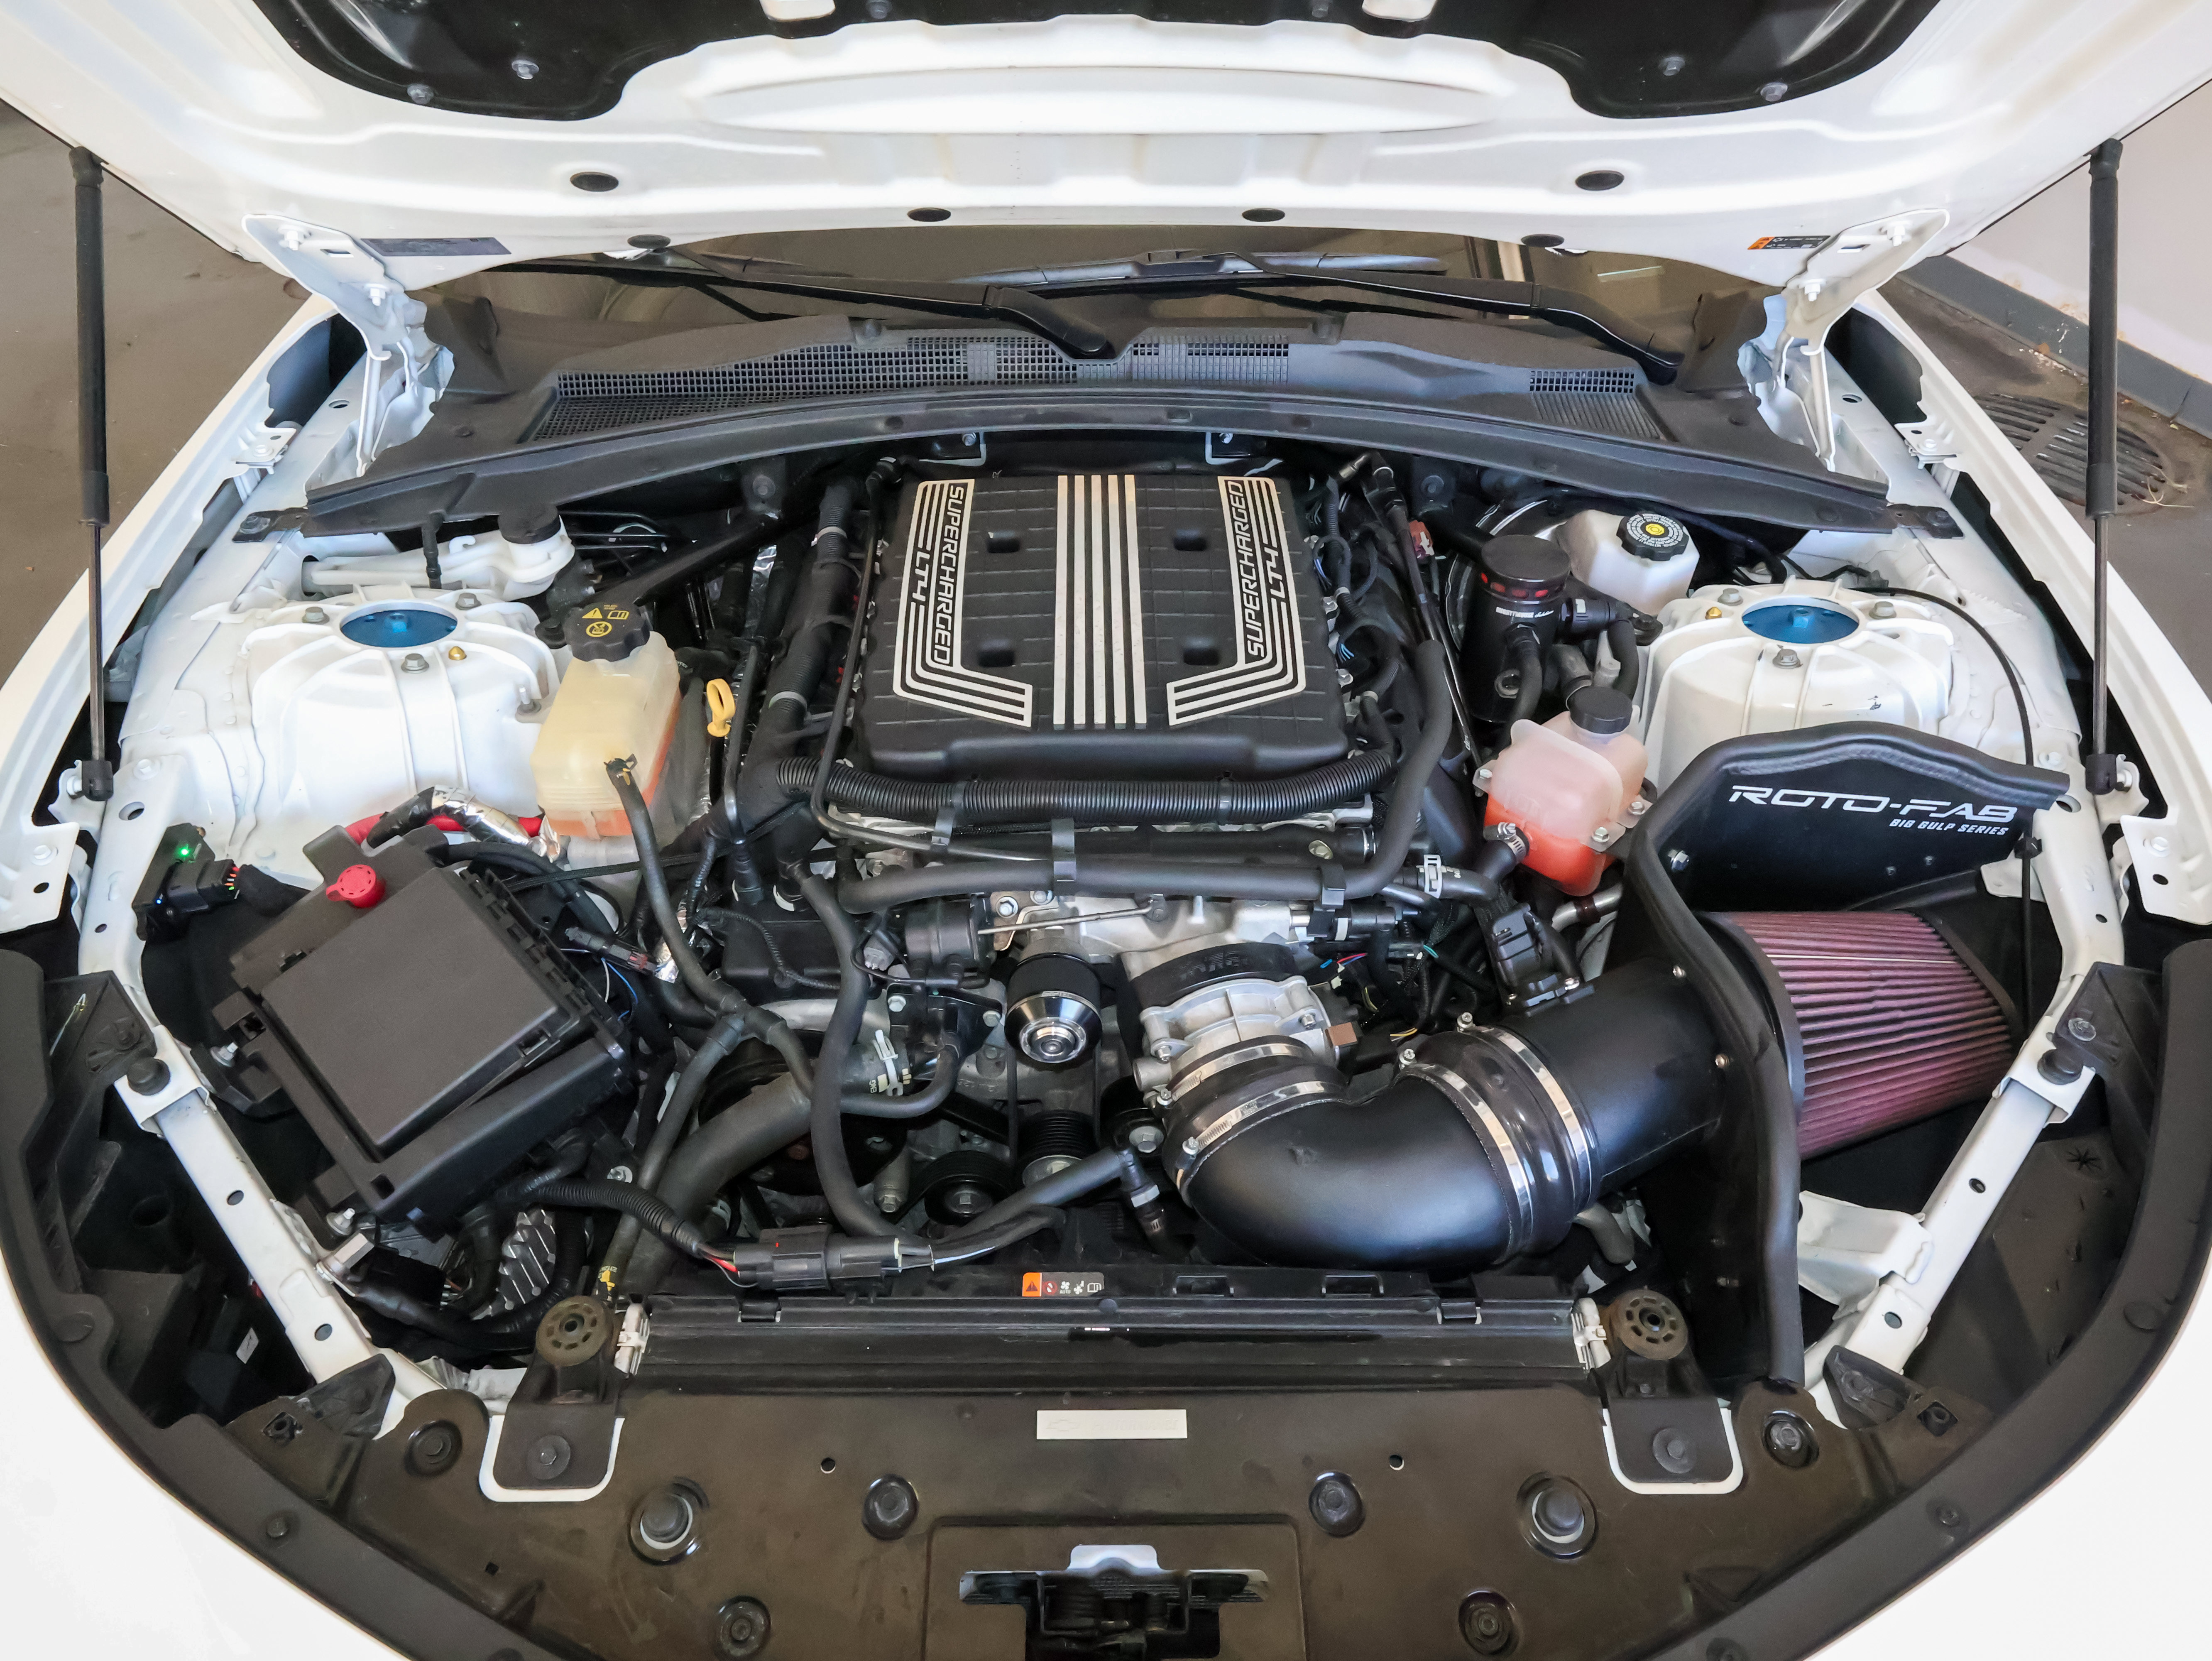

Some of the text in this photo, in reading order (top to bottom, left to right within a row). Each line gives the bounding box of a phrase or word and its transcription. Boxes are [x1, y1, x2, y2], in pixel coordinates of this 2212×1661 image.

[912, 551, 930, 602] LT4
[933, 485, 964, 664] SUPERCHARGED
[1228, 480, 1265, 658] SUPERCHARGED
[1264, 546, 1285, 599] LT4
[1728, 785, 2018, 823] ROTO-FAB
[1889, 818, 2009, 835] BIG GULP SERIES
[869, 1079, 877, 1093] ENG
